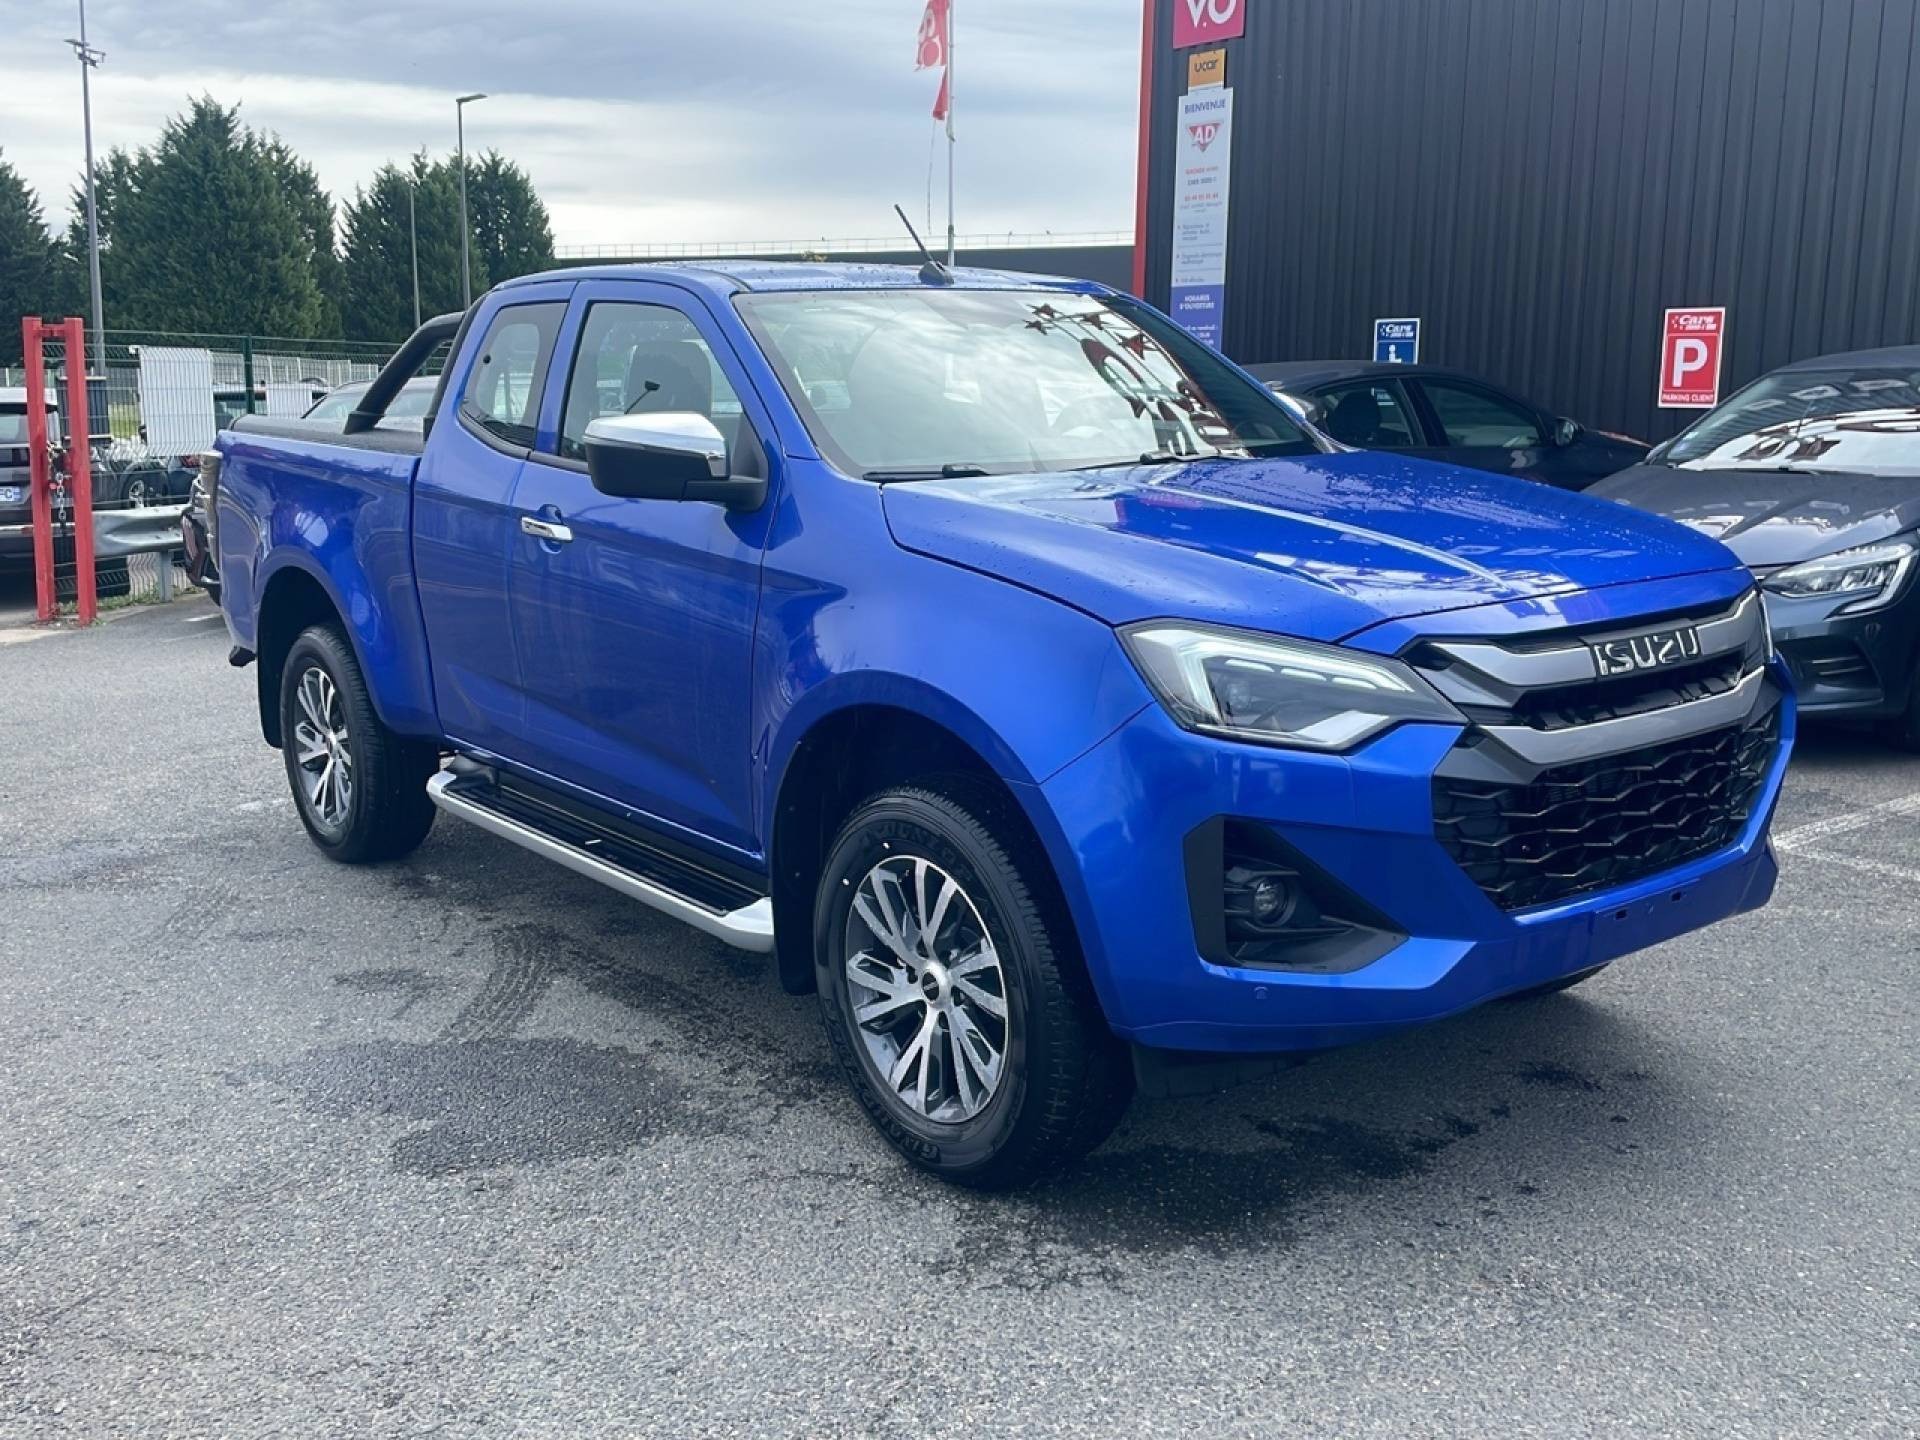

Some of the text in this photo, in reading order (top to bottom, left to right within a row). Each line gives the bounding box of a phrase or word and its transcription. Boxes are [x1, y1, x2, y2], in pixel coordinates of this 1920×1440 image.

[1184, 98, 1226, 114] BIENVENUE
[1195, 125, 1216, 145] AD
[1672, 338, 1708, 388] P
[1662, 393, 1714, 402] PARKING CLIENT
[1593, 627, 1699, 676] ISUZU
